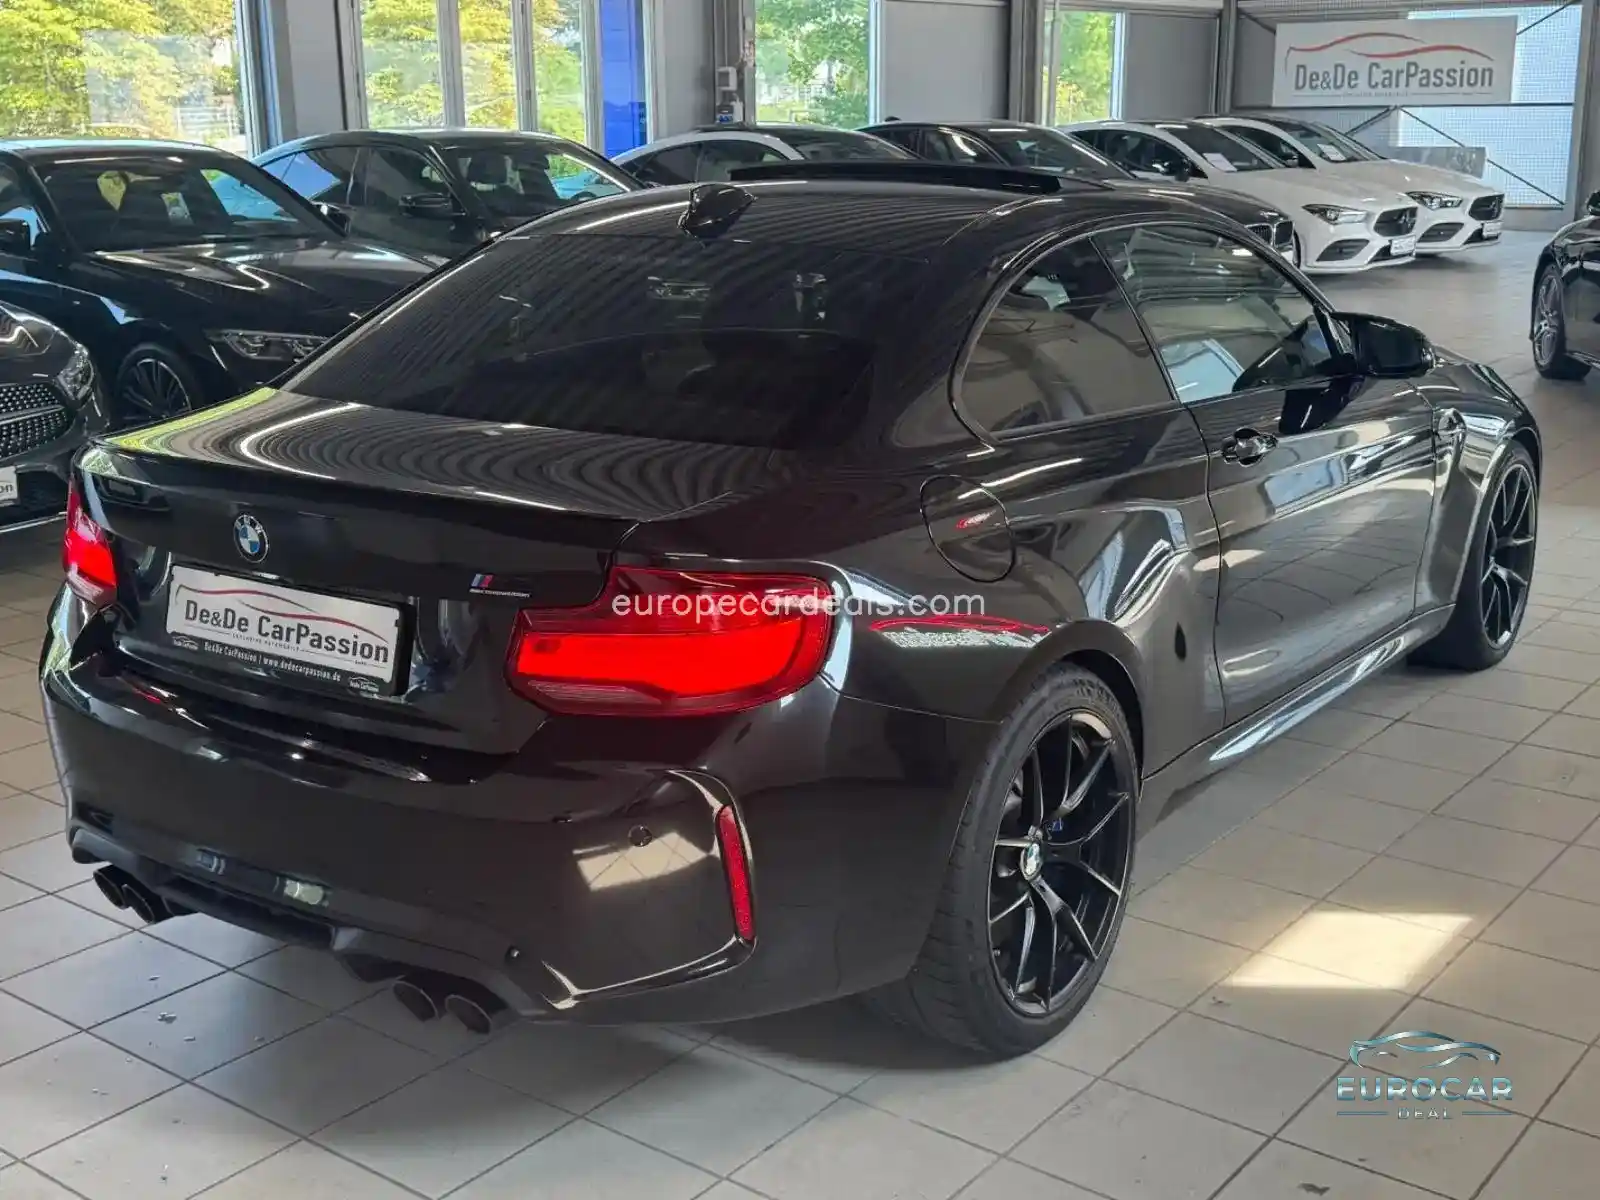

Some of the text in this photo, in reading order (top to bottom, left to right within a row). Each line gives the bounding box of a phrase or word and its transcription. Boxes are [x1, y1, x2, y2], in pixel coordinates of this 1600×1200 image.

[1294, 60, 1494, 91] De&De CarPassion
[184, 599, 389, 663] De&De CarPassion
